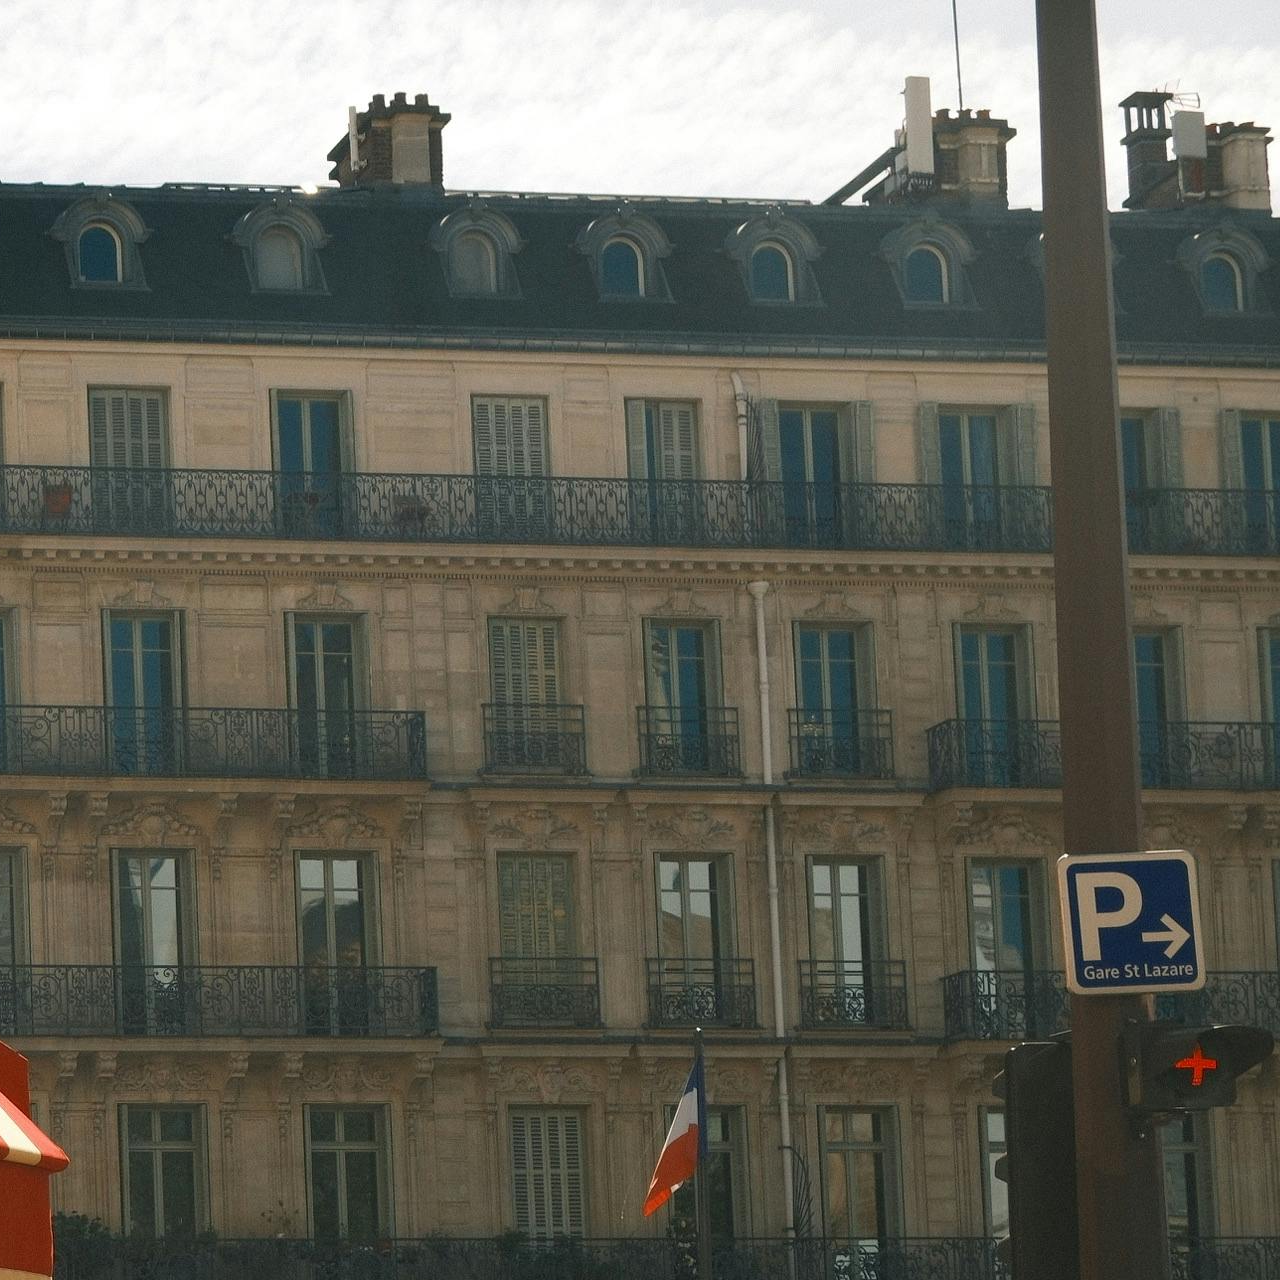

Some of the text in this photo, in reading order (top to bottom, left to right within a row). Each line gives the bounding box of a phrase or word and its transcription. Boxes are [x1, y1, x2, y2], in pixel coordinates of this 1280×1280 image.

[1075, 872, 1143, 962] P
[1084, 964, 1194, 980] Gare St Lazare
